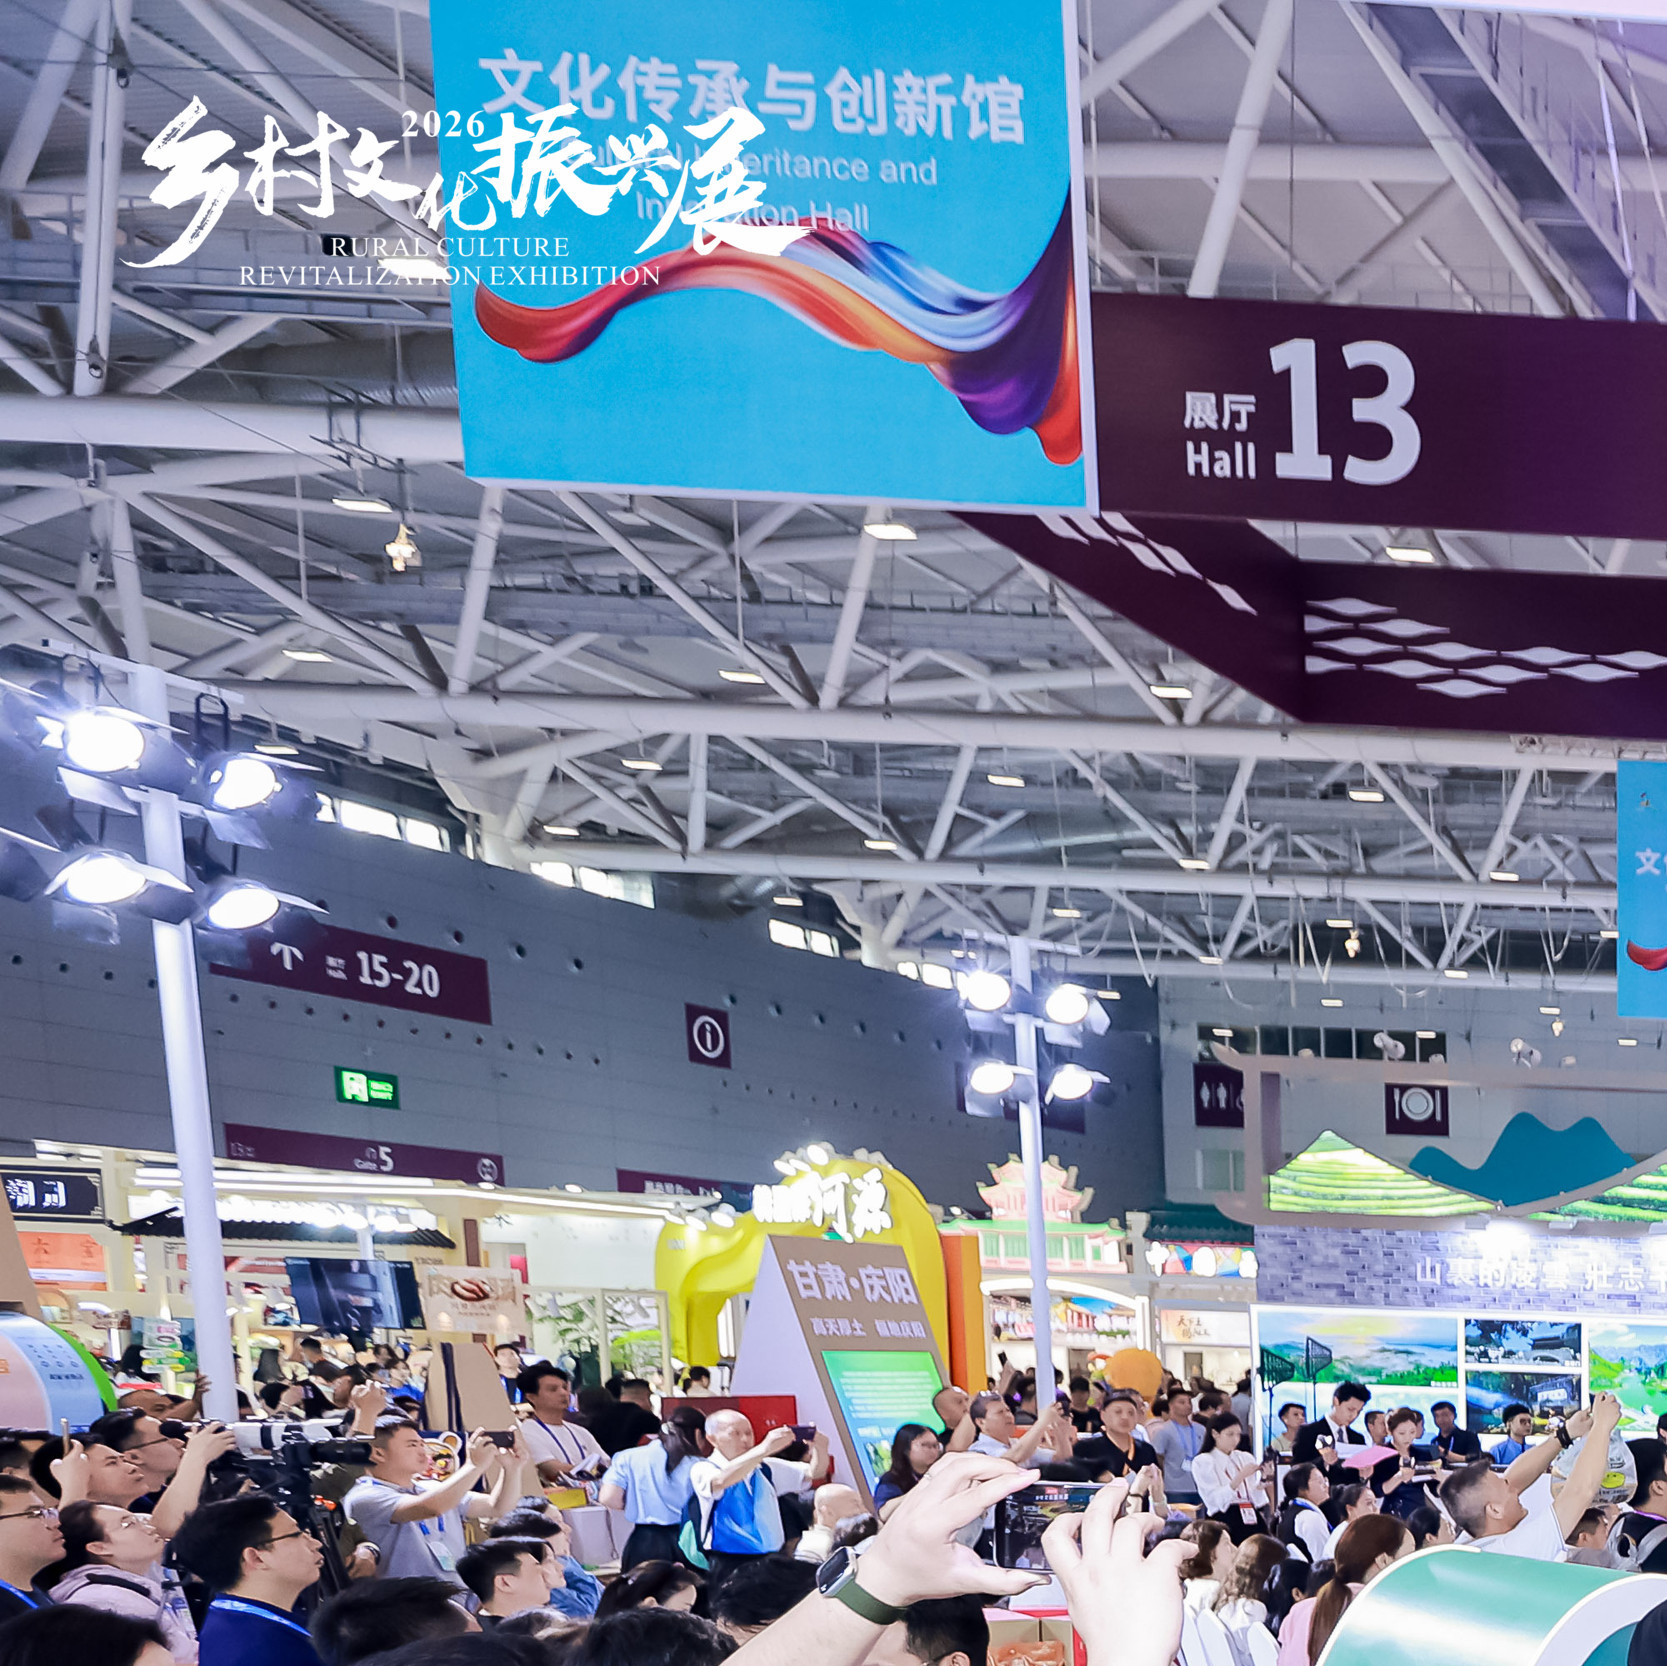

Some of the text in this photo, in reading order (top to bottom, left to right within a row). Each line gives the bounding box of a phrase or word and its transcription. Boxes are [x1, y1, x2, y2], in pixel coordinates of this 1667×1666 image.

[478, 47, 1025, 146] 文化传承与创新馆
[879, 158, 938, 187] and
[810, 204, 870, 233] Hall
[1184, 337, 1422, 487] 展厅 13
[1185, 440, 1257, 481] Hall
[356, 950, 441, 998] 15-20
[376, 1144, 394, 1173] 5
[786, 1258, 920, 1305] 甘肃·庆阳
